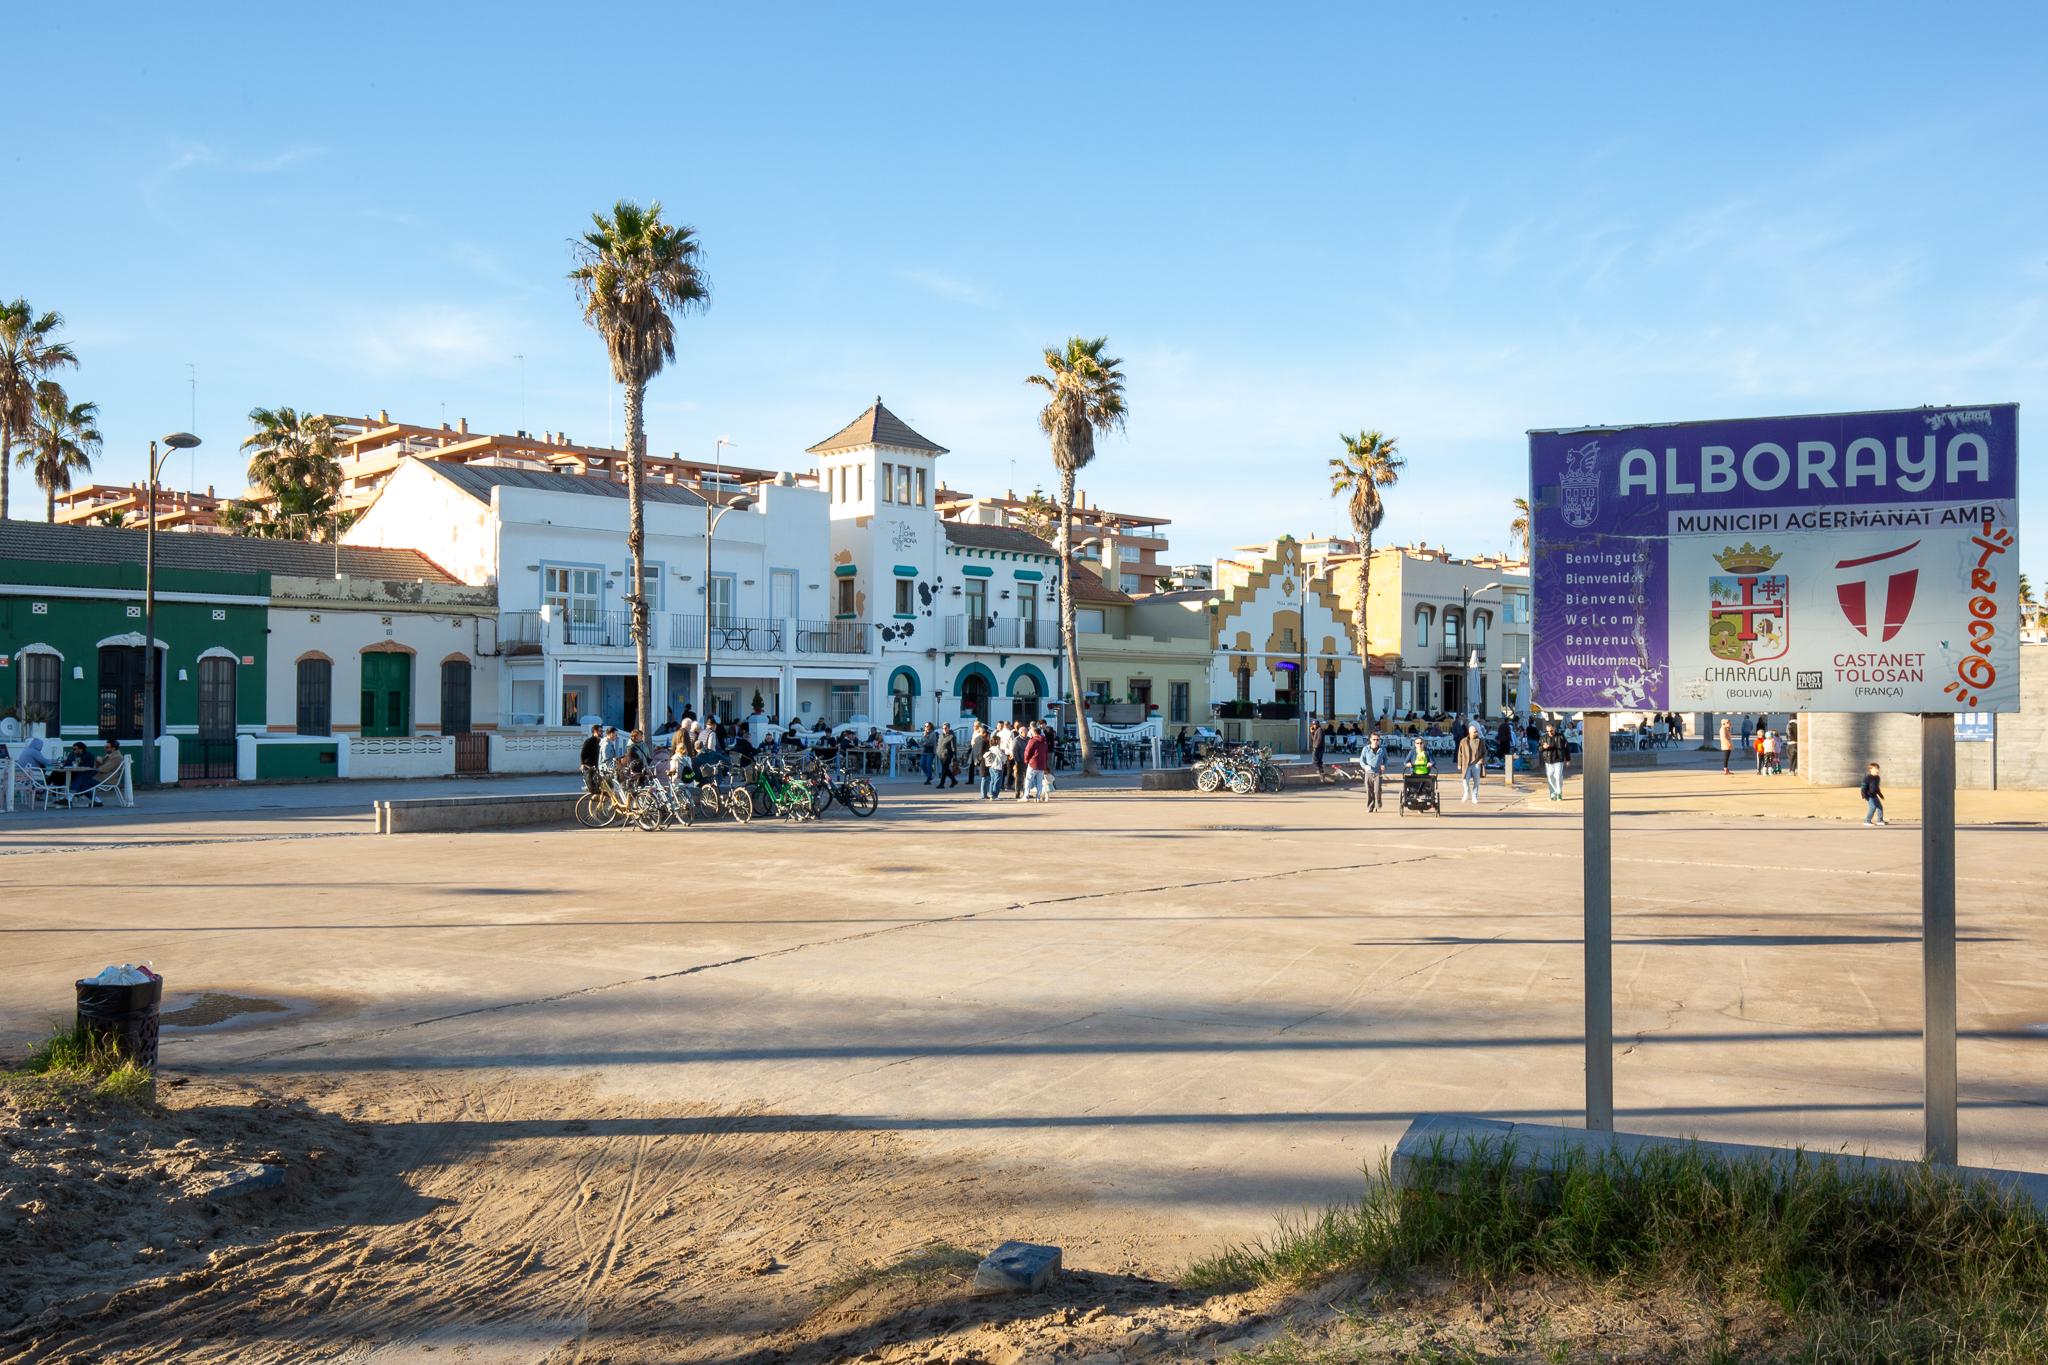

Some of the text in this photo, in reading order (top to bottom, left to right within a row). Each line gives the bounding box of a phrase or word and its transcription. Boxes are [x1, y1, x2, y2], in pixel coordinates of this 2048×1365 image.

[1619, 433, 1990, 496] ALBORAYA
[1677, 506, 1996, 532] MUNICIPI AGERMANAT AMB
[1566, 552, 1645, 566] Benvinguts
[1566, 572, 1645, 584] Bienvenidos
[1566, 594, 1645, 605] Bienvenue
[1566, 614, 1645, 625] Welcome
[1566, 655, 1645, 666] Willkommen
[1833, 653, 1926, 667] CASTANET
[1705, 667, 1791, 682] CHARAGUA
[1797, 673, 1822, 684] FROST
[1834, 669, 1924, 683] TOLOSAN
[1797, 681, 1809, 689] ALL
[1726, 688, 1773, 700] (BOLIVIA)
[1854, 686, 1904, 699] (FRANÇA)
